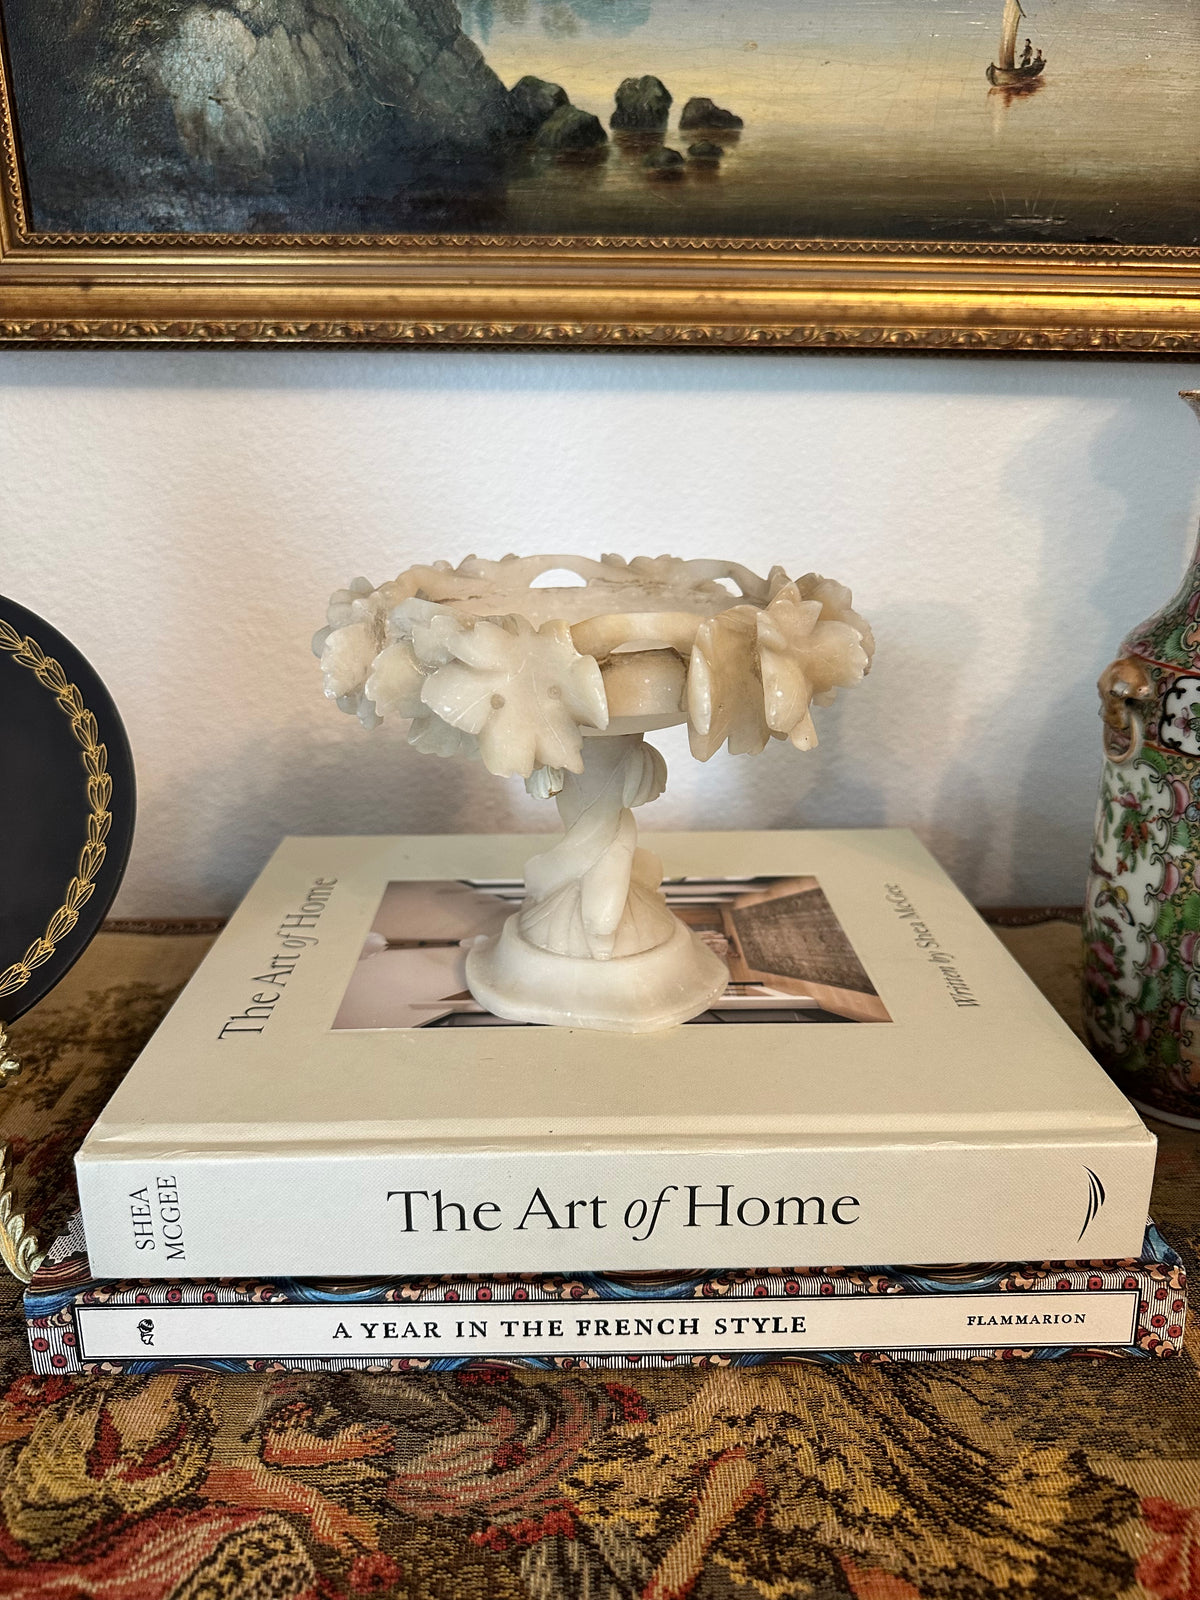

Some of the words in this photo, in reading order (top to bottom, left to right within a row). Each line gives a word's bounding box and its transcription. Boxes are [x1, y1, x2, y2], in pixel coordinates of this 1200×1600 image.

[280, 877, 339, 930] Home
[275, 929, 320, 950] of
[909, 920, 942, 950] Shea
[250, 953, 302, 988] Art
[926, 950, 956, 965] by
[937, 965, 982, 1008] Written
[216, 991, 281, 1040] The
[129, 1185, 156, 1251] SHEA
[156, 1174, 187, 1262] MCGEE
[386, 1187, 503, 1233] The
[512, 1186, 608, 1231] Art
[623, 1184, 680, 1242] of
[682, 1182, 861, 1228] Home
[331, 1321, 353, 1340] A
[359, 1320, 442, 1339] YEAR
[455, 1320, 489, 1339] IN
[499, 1319, 565, 1339] THE
[575, 1317, 700, 1337] FRENCH
[714, 1315, 807, 1336] STYLE
[966, 1312, 1088, 1327] FLAMMARION
